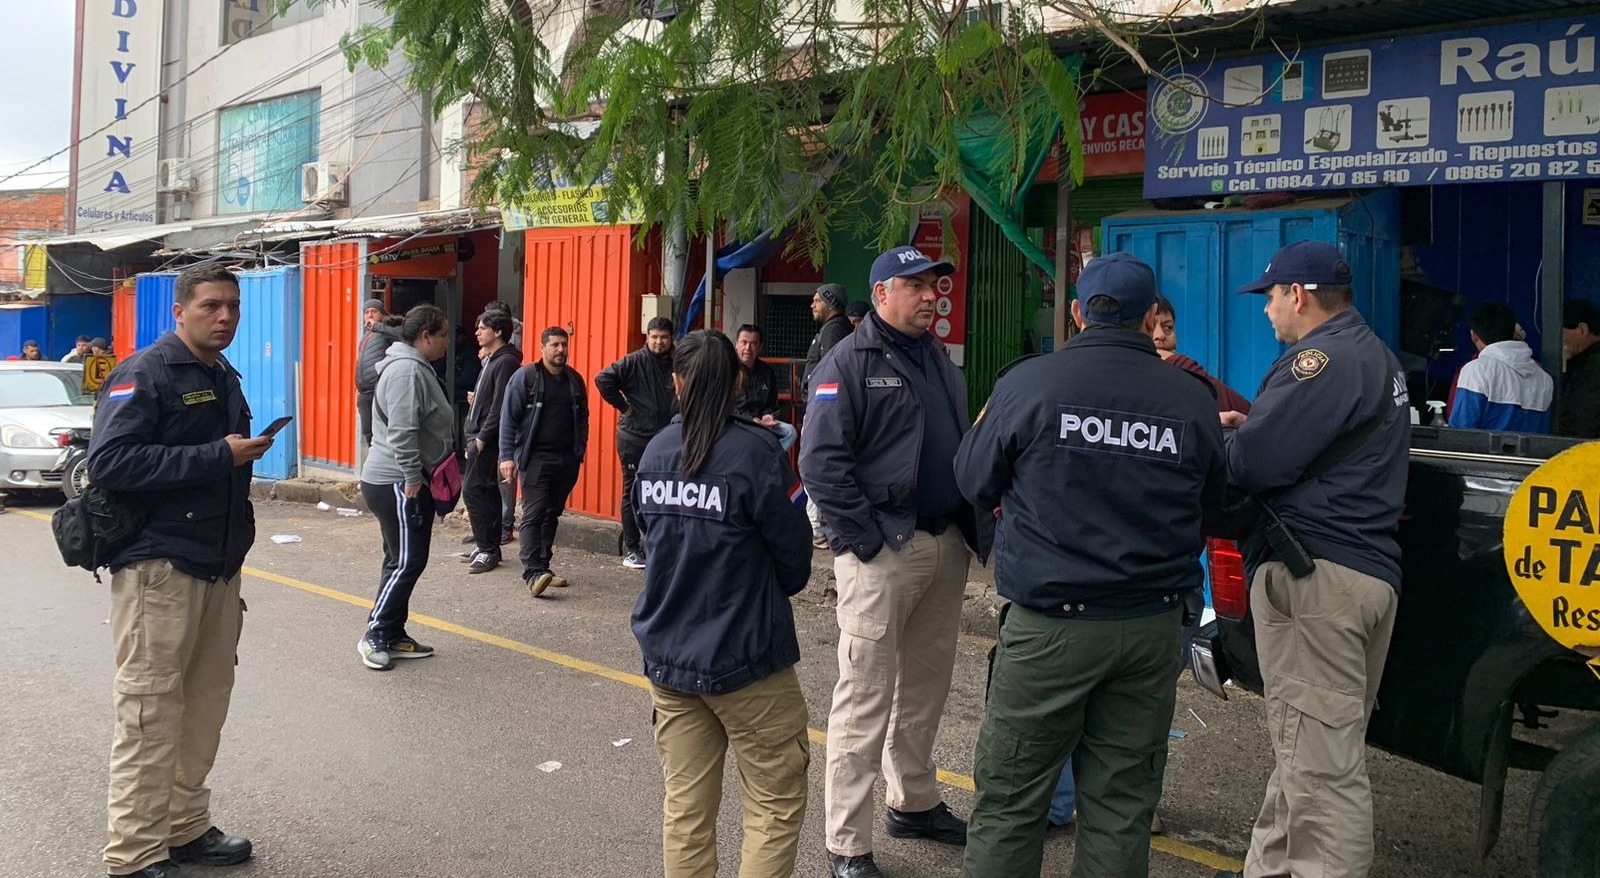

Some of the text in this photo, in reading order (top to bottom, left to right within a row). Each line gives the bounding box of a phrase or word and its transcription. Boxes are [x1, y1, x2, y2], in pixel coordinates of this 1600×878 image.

[1440, 23, 1595, 85] Raú
[104, 0, 137, 193] DIVINA
[1082, 141, 1117, 155] ENVIOS
[1158, 162, 1229, 180] Servicio
[1234, 158, 1303, 175] Técnico
[1309, 149, 1447, 172] Especializado
[1469, 140, 1598, 162] Repuestos
[1228, 178, 1259, 192] Cel.
[1265, 174, 1315, 190] 0984
[1320, 172, 1346, 187] 70
[1351, 171, 1378, 185] 85
[1383, 169, 1410, 184] 80
[1445, 164, 1504, 181] 0985
[1510, 162, 1541, 178] 20
[1548, 160, 1580, 176] 82
[78, 206, 113, 219] Celulares
[537, 203, 588, 215] ACCESORIOS
[552, 214, 590, 224] GENERAL
[1060, 413, 1178, 454] POLICIA
[641, 480, 723, 513] POLICIA
[1528, 485, 1600, 534] PA
[1514, 545, 1547, 581] de
[1552, 596, 1600, 632] Res
